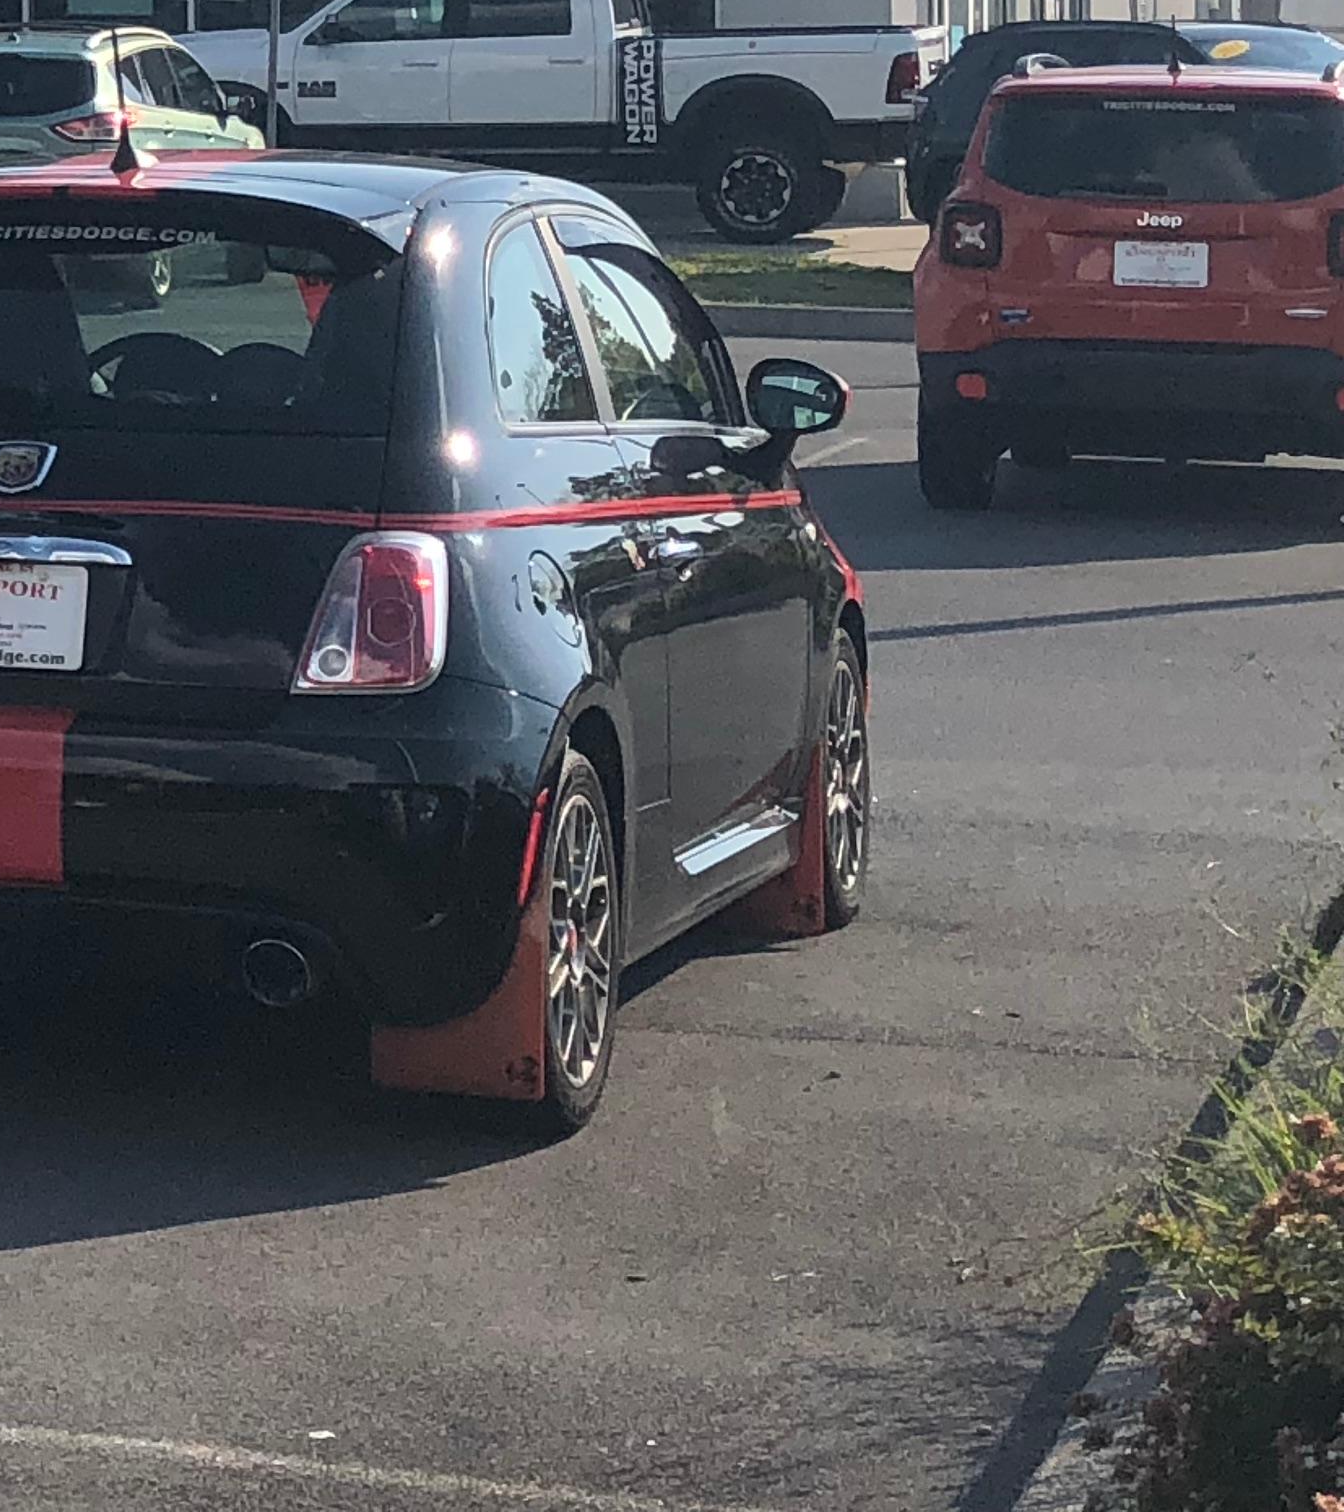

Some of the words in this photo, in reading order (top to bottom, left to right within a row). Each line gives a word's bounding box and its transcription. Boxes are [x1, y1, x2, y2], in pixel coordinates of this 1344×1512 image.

[623, 38, 642, 144] WAGON
[639, 40, 658, 144] POWER
[1136, 211, 1184, 229] Jeep
